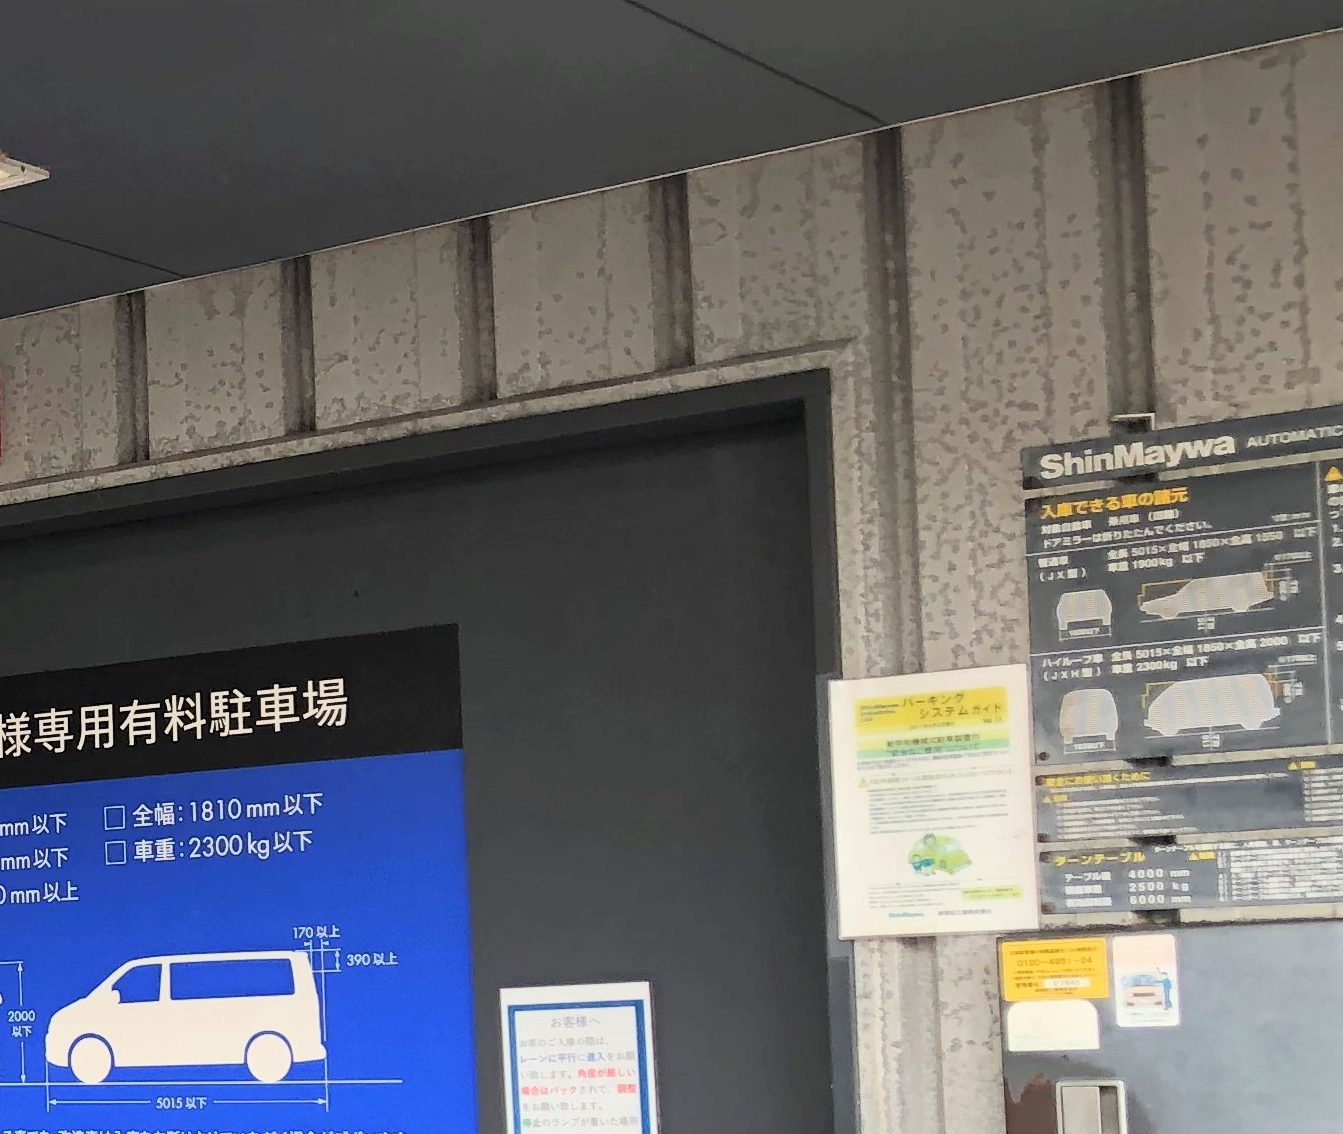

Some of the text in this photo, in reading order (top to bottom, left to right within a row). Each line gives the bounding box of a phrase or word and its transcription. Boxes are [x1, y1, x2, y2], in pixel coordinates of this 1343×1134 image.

[1040, 434, 1236, 480] ShinMaywa
[1054, 852, 1145, 867] ターンテーブル
[1128, 869, 1164, 879] 4000
[1128, 882, 1164, 892] 2500
[8, 1010, 36, 1023] 2000
[550, 1016, 601, 1028] お客様へ
[12, 1025, 33, 1038] 以下
